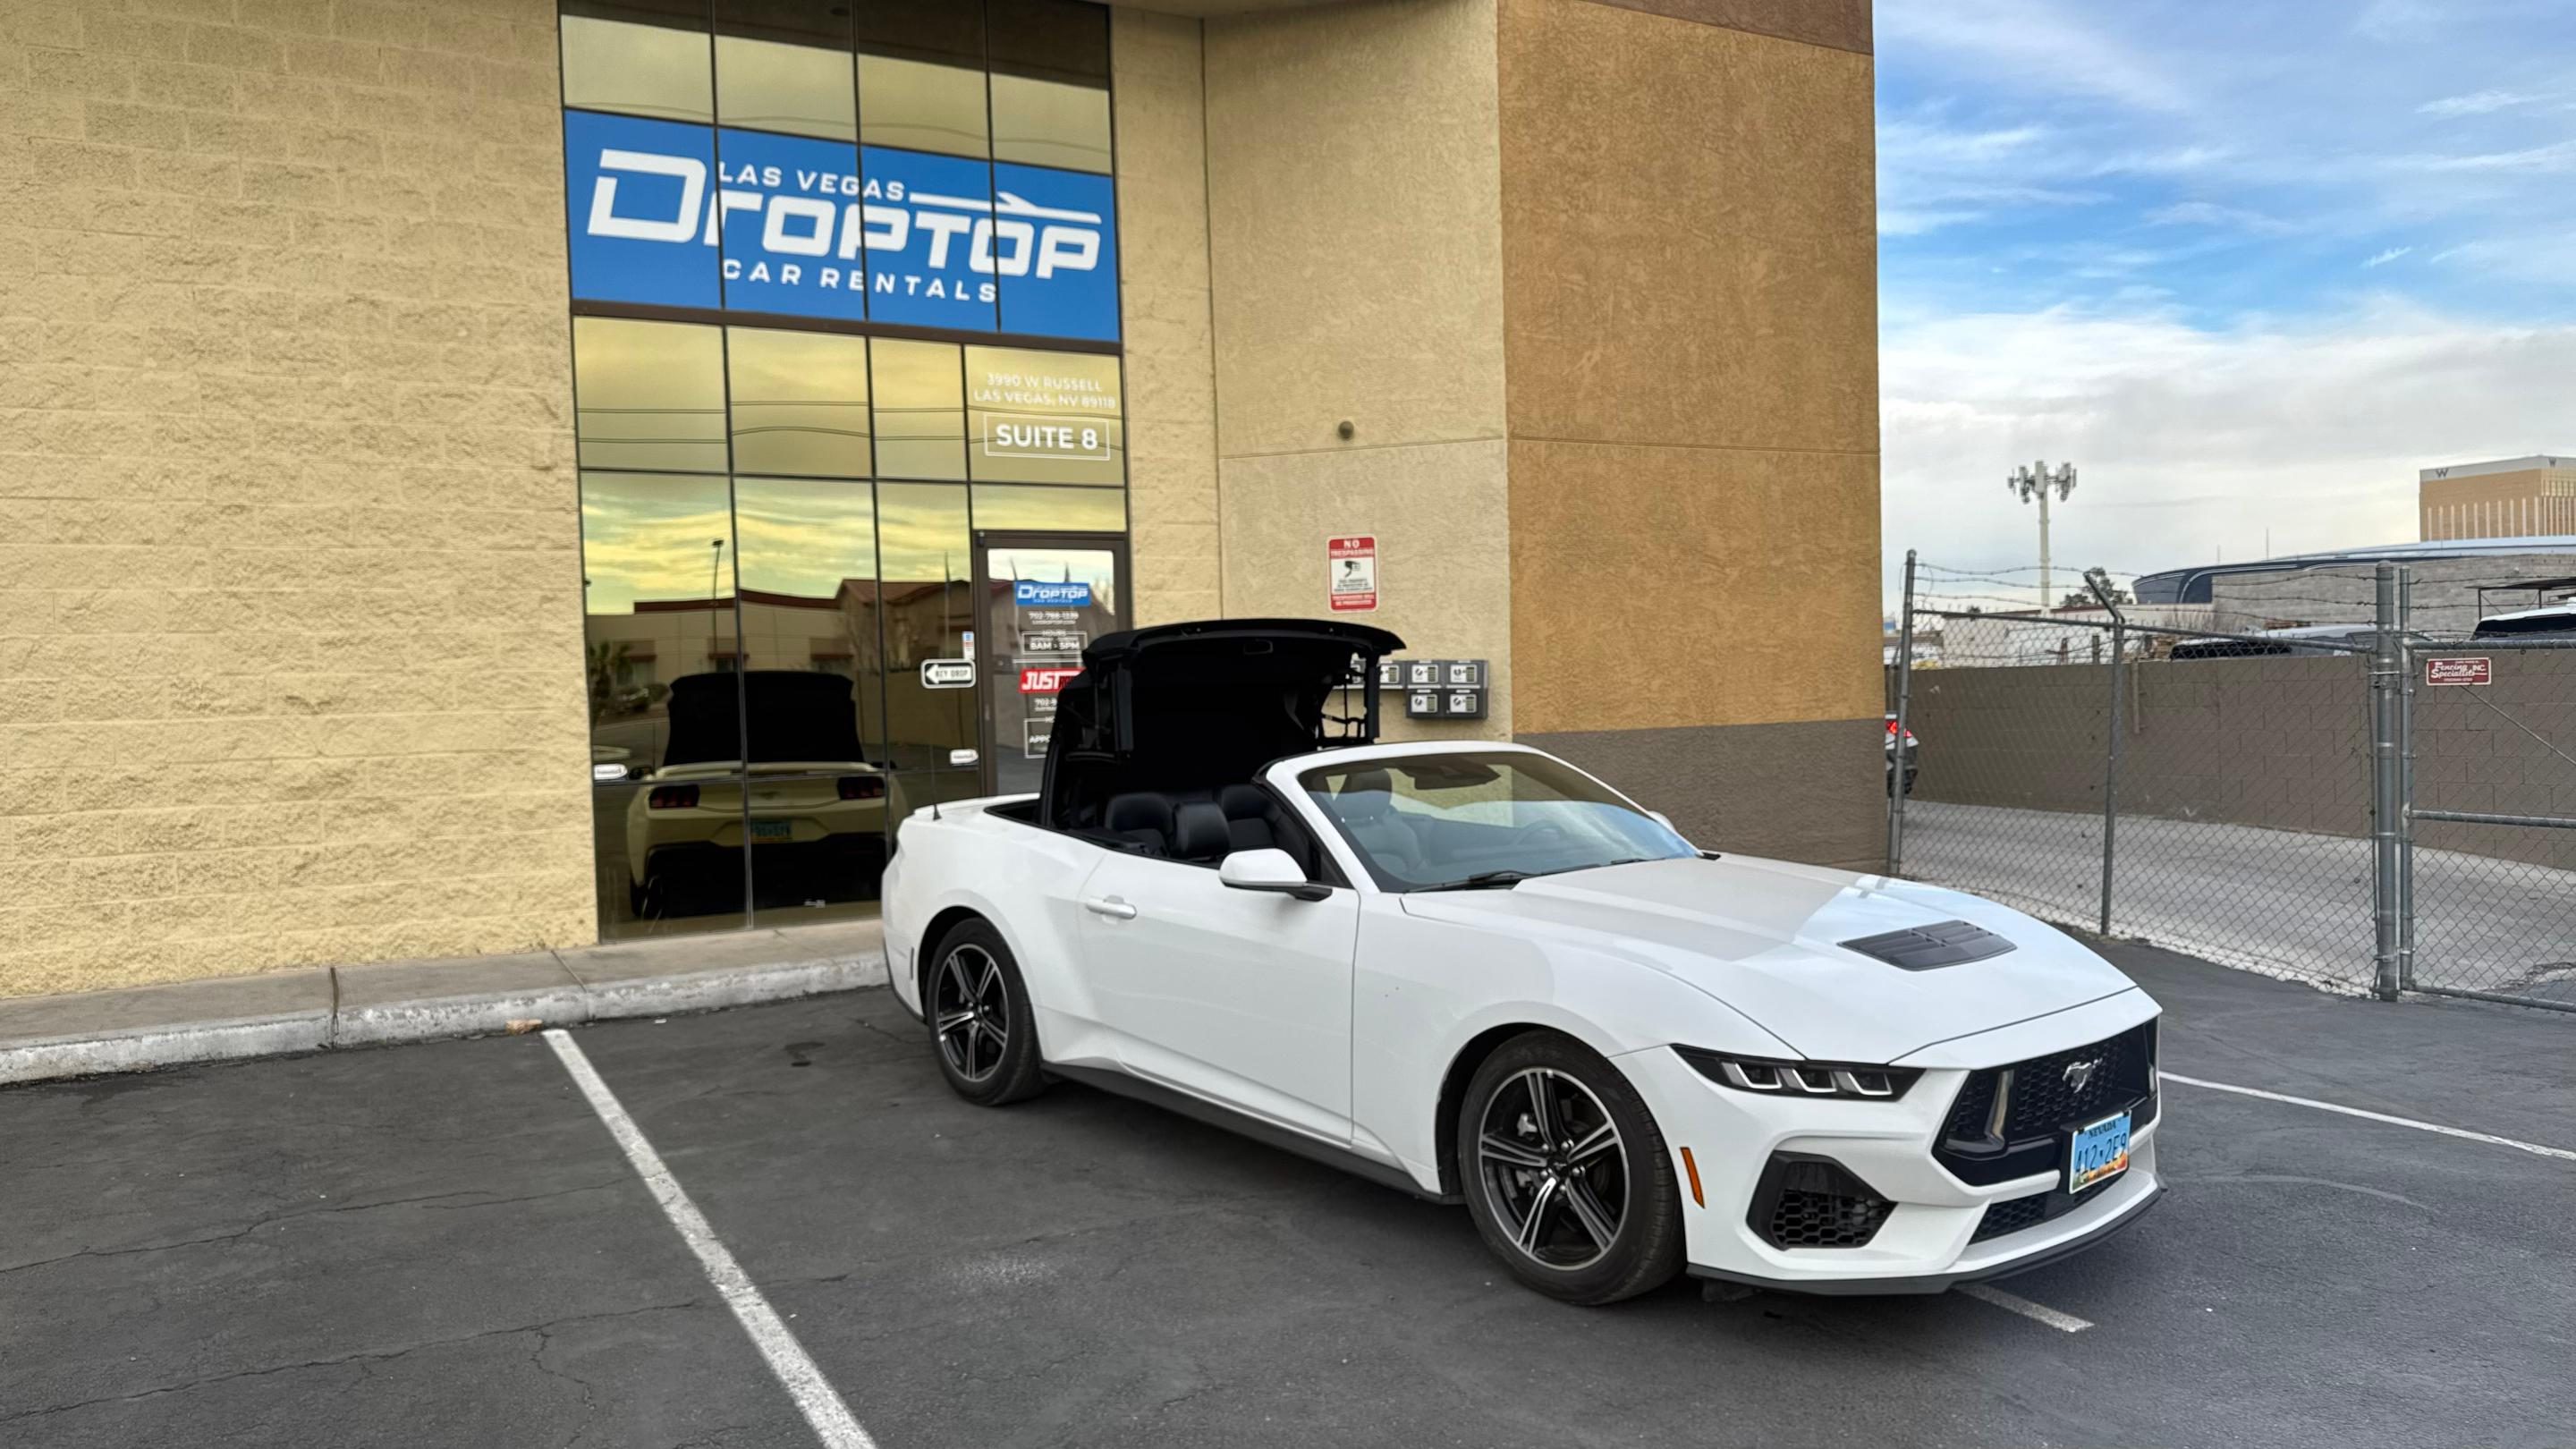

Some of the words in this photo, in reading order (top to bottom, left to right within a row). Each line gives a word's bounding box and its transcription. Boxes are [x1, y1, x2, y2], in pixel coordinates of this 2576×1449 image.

[718, 161, 782, 187] LAS
[796, 170, 904, 201] VEGAS
[723, 258, 801, 285] CAR
[820, 267, 996, 302] RENTALS
[987, 372, 1021, 387] 3990
[1024, 375, 1039, 388] W
[1043, 377, 1102, 393] RUSSELL
[974, 389, 1001, 402] LAS
[1059, 394, 1079, 407] NV
[1080, 396, 1116, 410] 89118
[996, 424, 1074, 449] SUITE
[1081, 428, 1098, 450] 8
[2548, 457, 2556, 468] W
[2436, 468, 2449, 478] W
[1343, 538, 1360, 549] NO
[951, 669, 969, 678] DROP
[1021, 671, 1080, 691] JUST
[2431, 668, 2475, 679] Specialists
